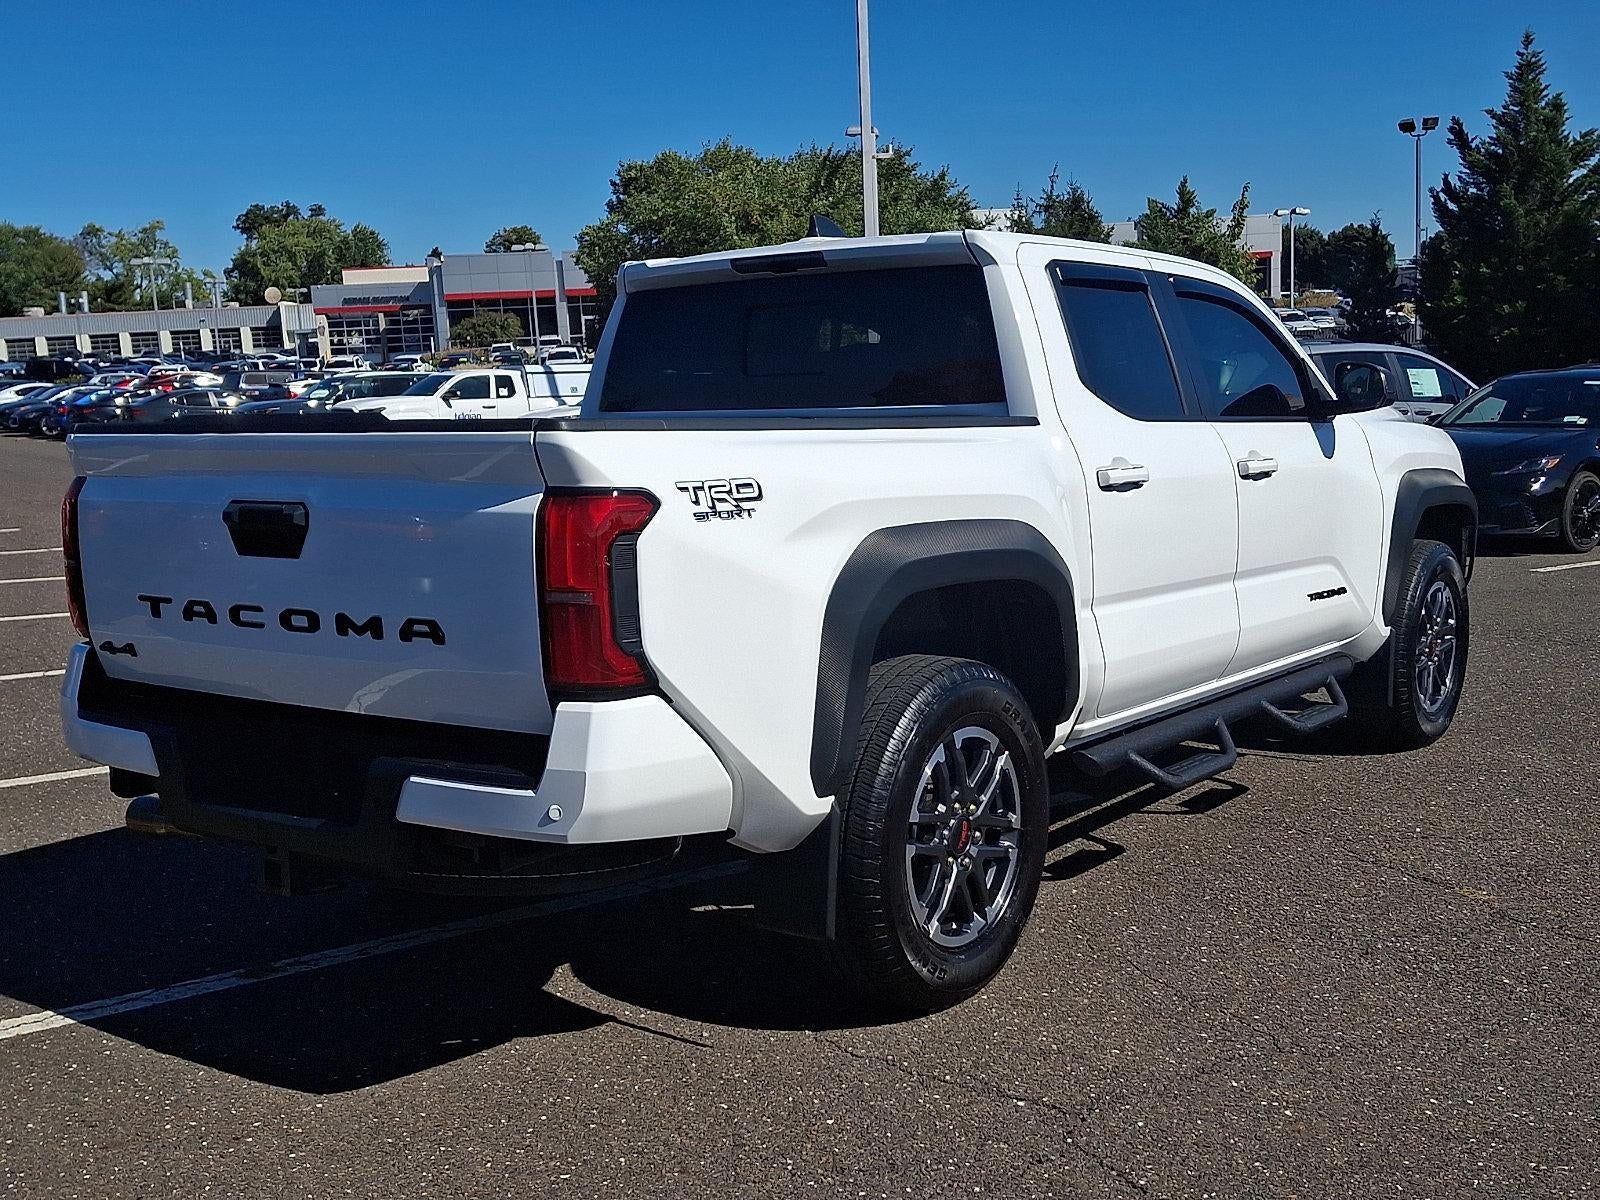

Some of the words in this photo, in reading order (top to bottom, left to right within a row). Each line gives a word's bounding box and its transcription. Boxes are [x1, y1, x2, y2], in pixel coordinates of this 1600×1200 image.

[675, 477, 763, 511] TRD
[693, 508, 756, 522] SPORT
[1307, 586, 1347, 602] TACOMA
[137, 593, 446, 646] TACOMA
